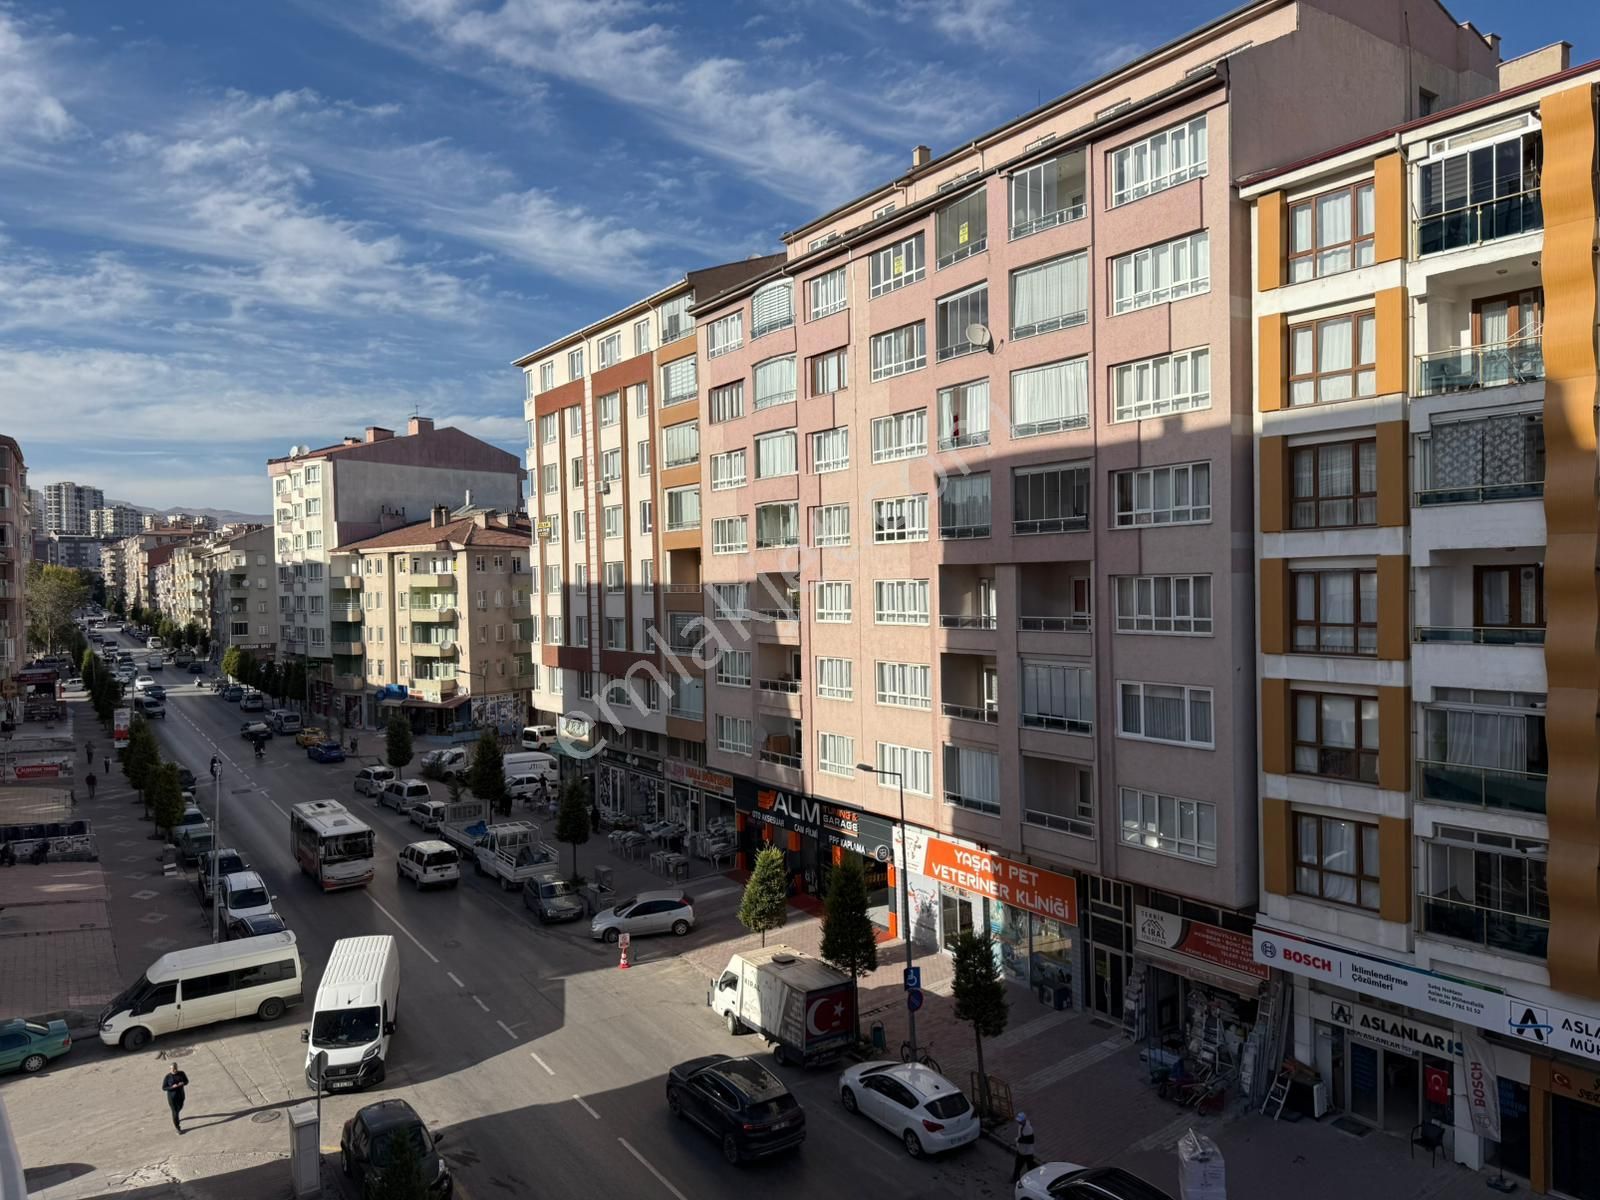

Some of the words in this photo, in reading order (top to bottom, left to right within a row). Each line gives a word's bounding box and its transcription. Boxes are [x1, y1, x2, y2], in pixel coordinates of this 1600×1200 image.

[773, 792, 821, 825] ALM
[823, 805, 852, 820] TUNING
[823, 815, 859, 833] GARAGE
[840, 838, 866, 855] KAPLAMA
[954, 849, 1003, 876] YAŞAM
[1008, 866, 1039, 887] PET
[932, 863, 1009, 899] VETERİNER
[1015, 888, 1069, 919] KLİNİĞİ
[1141, 926, 1166, 939] KIRAL
[1283, 948, 1332, 972] BOSCH
[1351, 963, 1408, 987] İklimlendirme
[1352, 974, 1393, 991] Çözümleri
[1360, 1014, 1445, 1052] ASLANLAR
[1470, 1062, 1486, 1107] BOSCH
